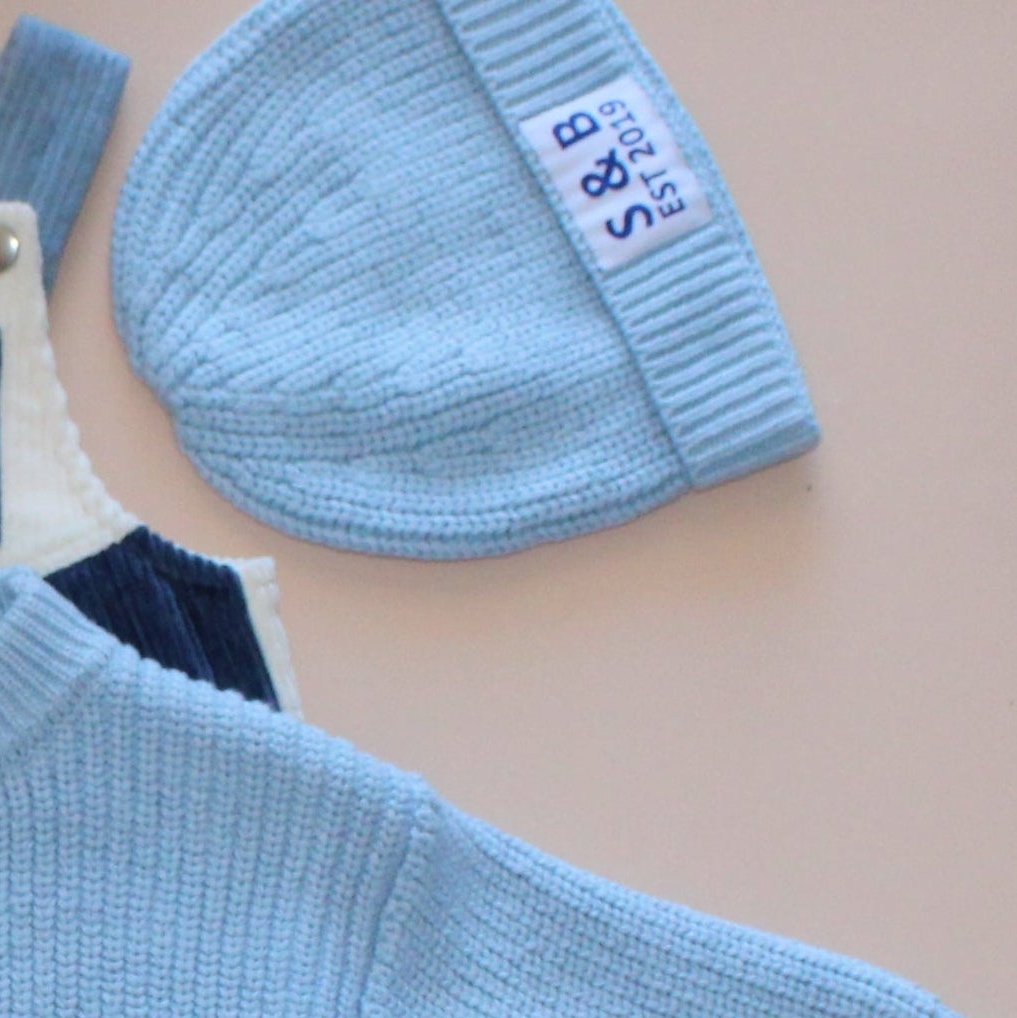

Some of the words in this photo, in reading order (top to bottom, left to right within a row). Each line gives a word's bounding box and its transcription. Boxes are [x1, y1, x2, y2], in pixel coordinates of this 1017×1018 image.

[552, 110, 601, 150] B
[598, 99, 657, 164] 2019
[581, 148, 629, 197] &
[640, 169, 686, 219] EST
[605, 203, 653, 239] S
